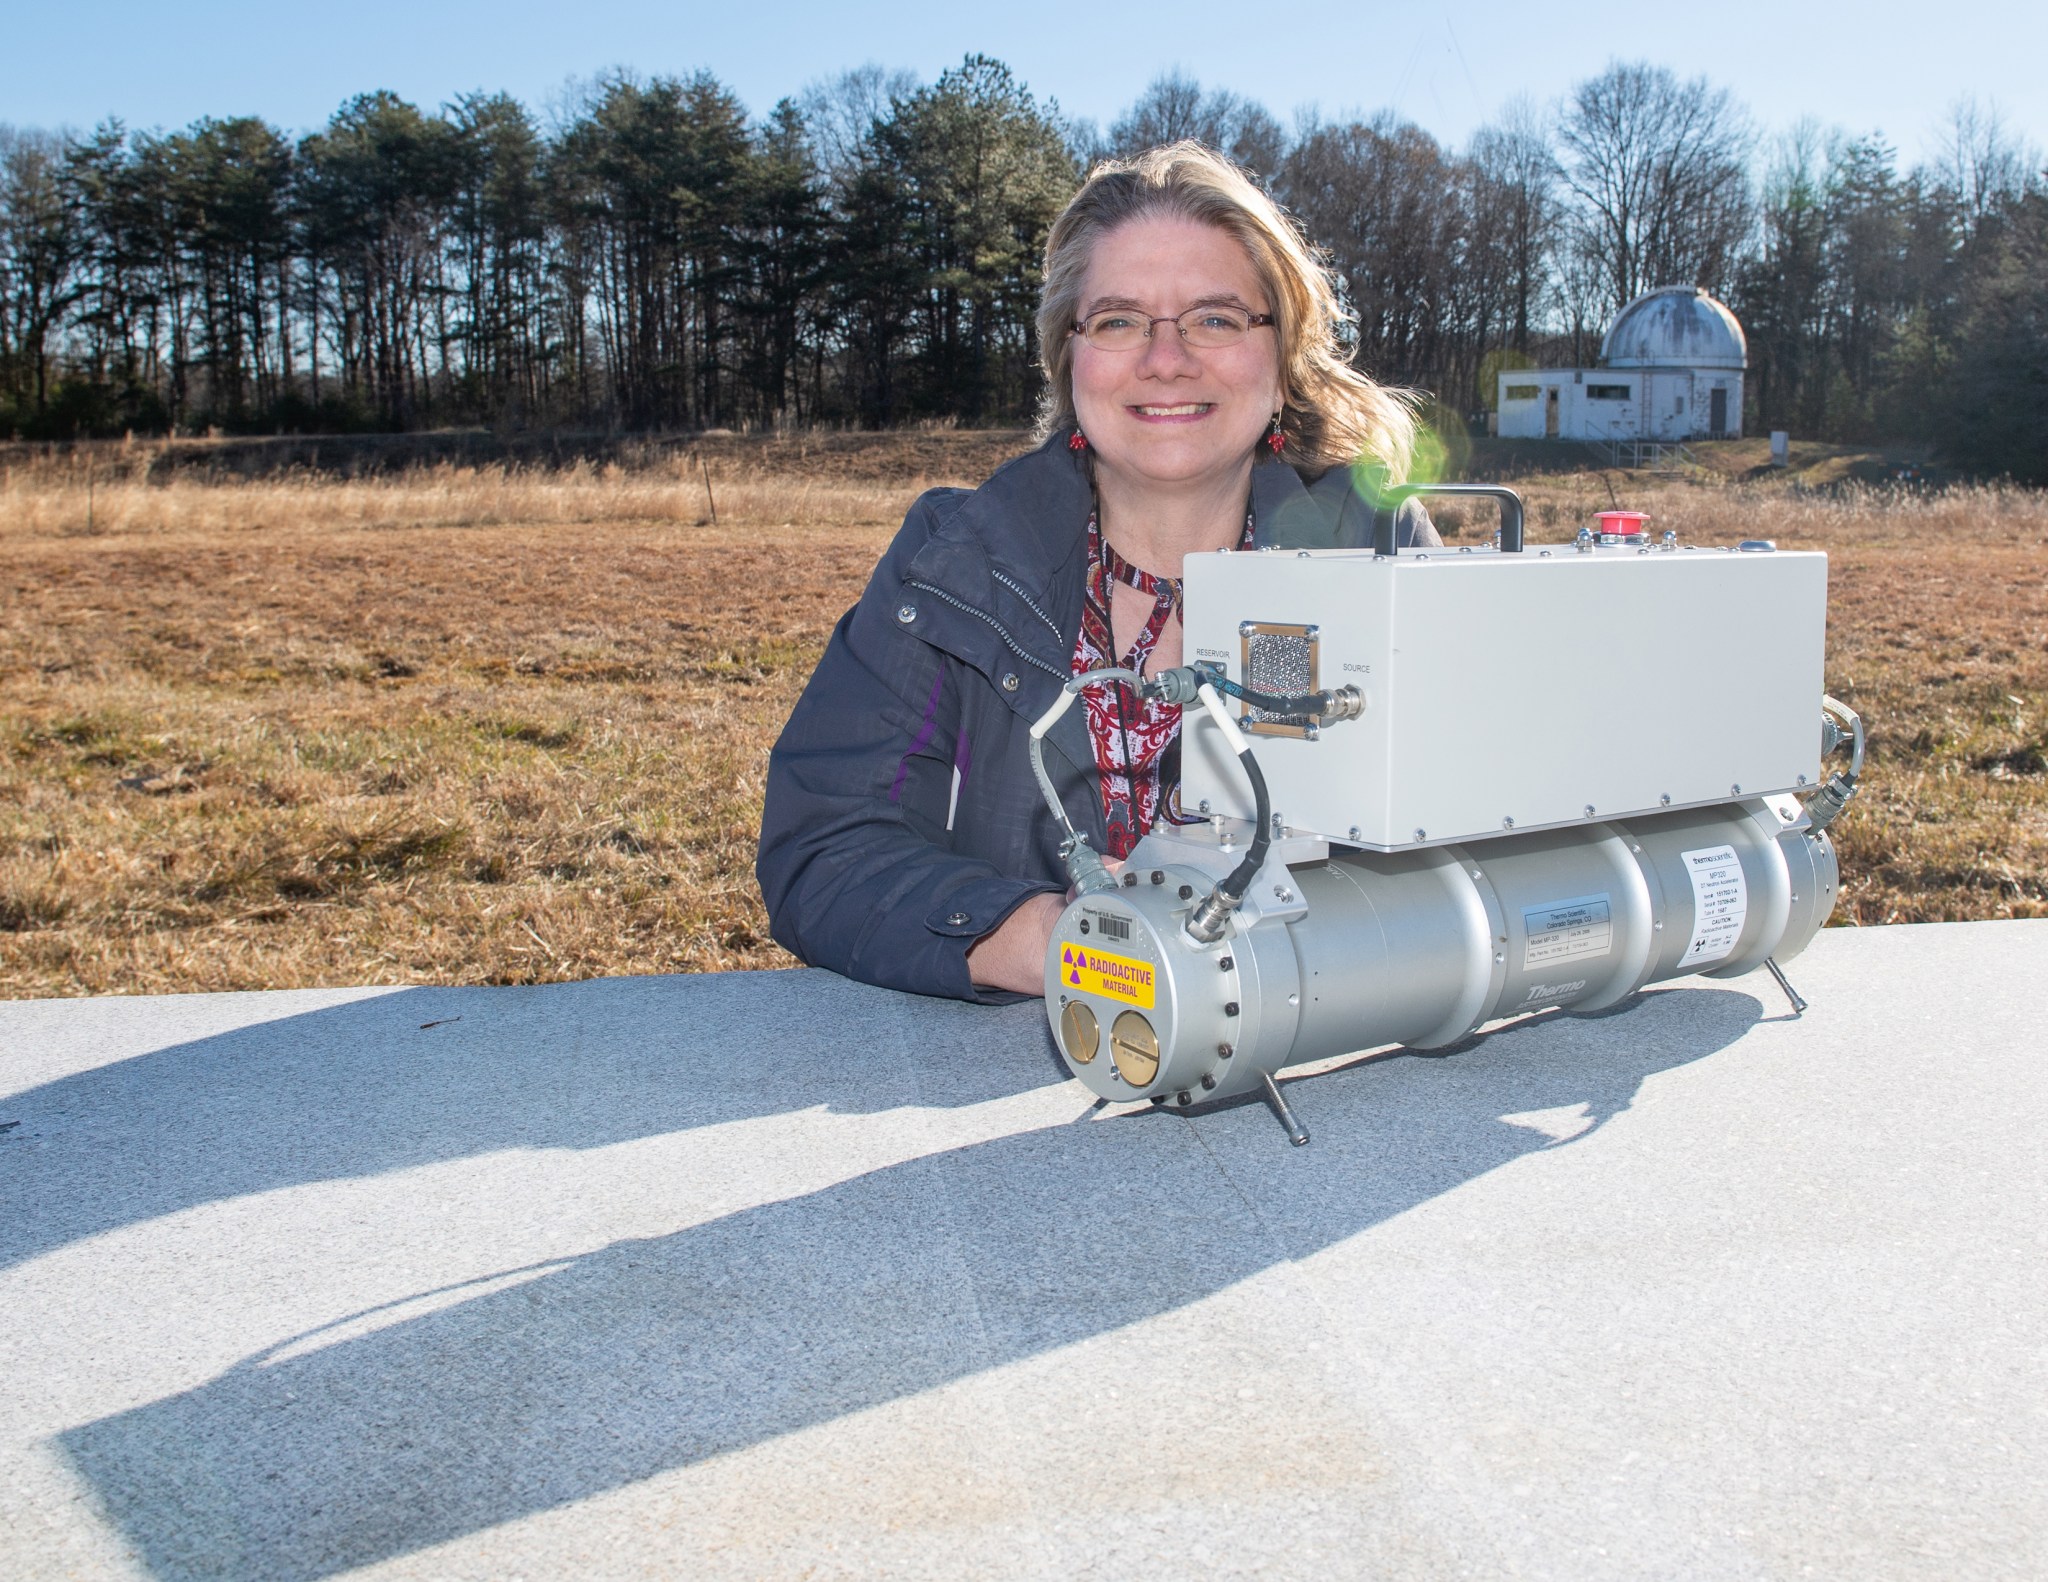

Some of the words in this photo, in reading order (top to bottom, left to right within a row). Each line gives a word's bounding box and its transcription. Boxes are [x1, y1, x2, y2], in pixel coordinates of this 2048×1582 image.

[1196, 648, 1230, 659] RESERVOIR
[1342, 663, 1371, 673] SOURCE
[1709, 871, 1726, 879] MP320
[1083, 907, 1097, 916] Property
[1110, 913, 1132, 922] Government
[1550, 912, 1567, 921] Thermo
[1567, 909, 1587, 918] Scientific
[1546, 920, 1566, 929] Colorado
[1090, 957, 1152, 986] RADIOACTIVE
[1103, 978, 1138, 998] MATERIAL
[1527, 979, 1586, 1000] Thermo
